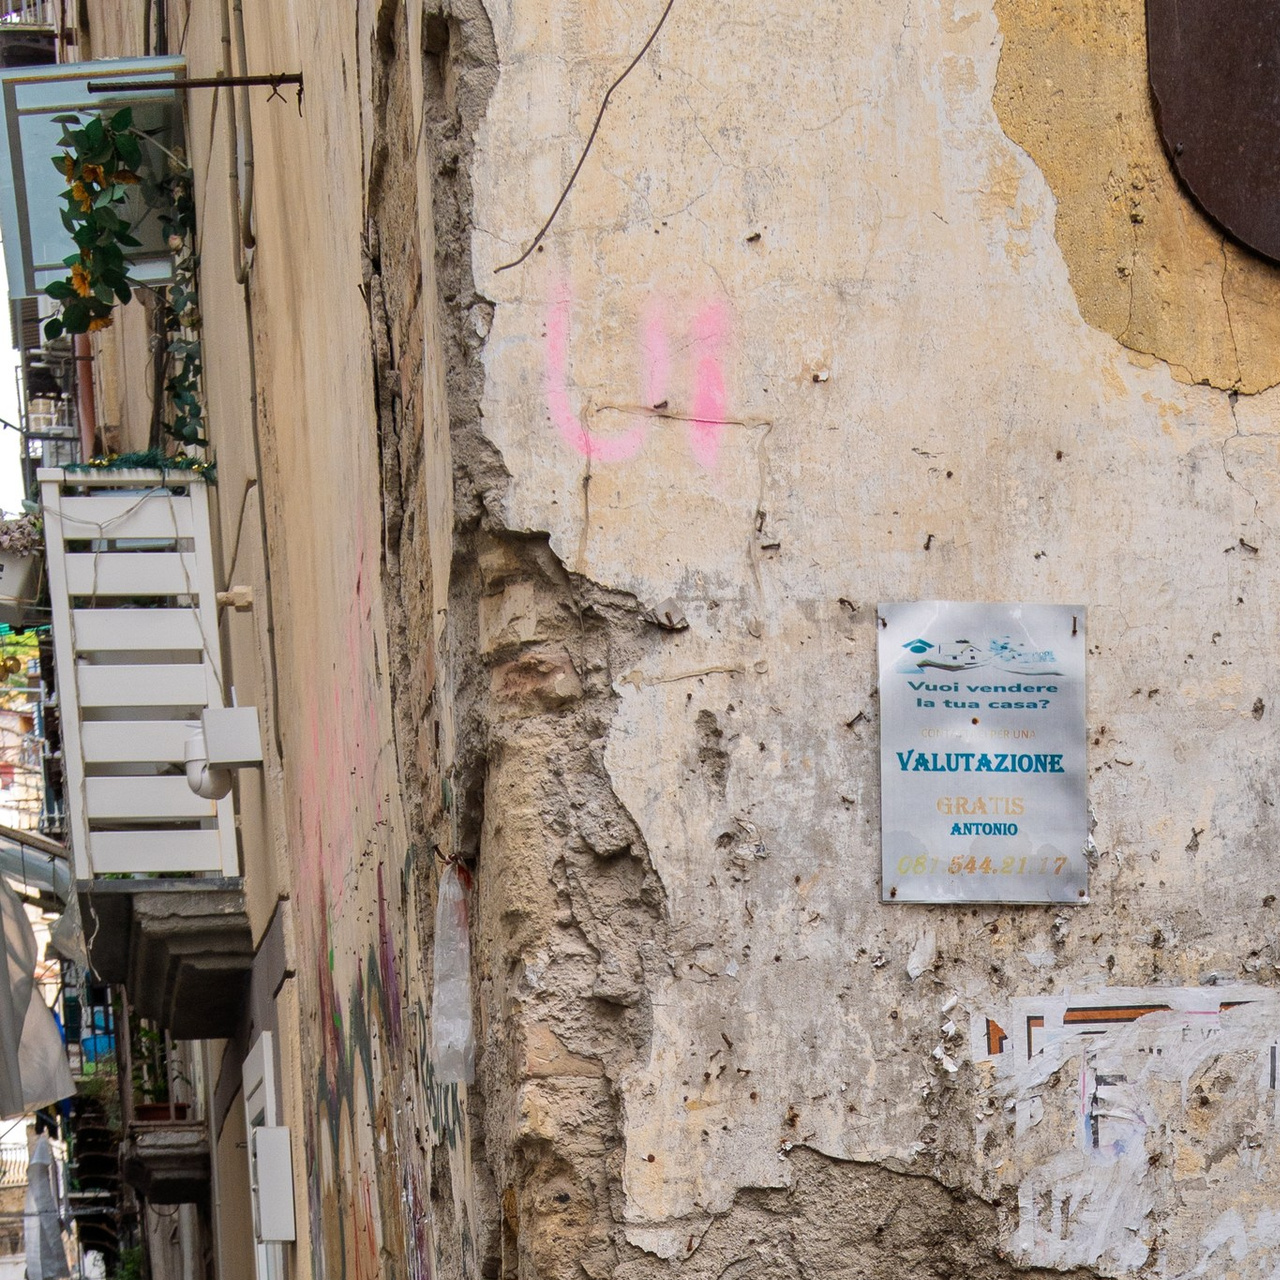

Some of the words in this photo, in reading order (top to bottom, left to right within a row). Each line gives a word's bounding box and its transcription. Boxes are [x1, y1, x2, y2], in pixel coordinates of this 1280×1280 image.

[907, 680, 959, 692] Vuoi
[966, 683, 1058, 693] vendere
[916, 698, 936, 708] la
[943, 699, 980, 709] tua
[988, 699, 1050, 709] casa?
[1013, 729, 1036, 740] UNA
[896, 748, 1065, 774] VALUTAZIONE
[936, 796, 1026, 816] GRATIS
[950, 822, 1018, 836] ANTONIO
